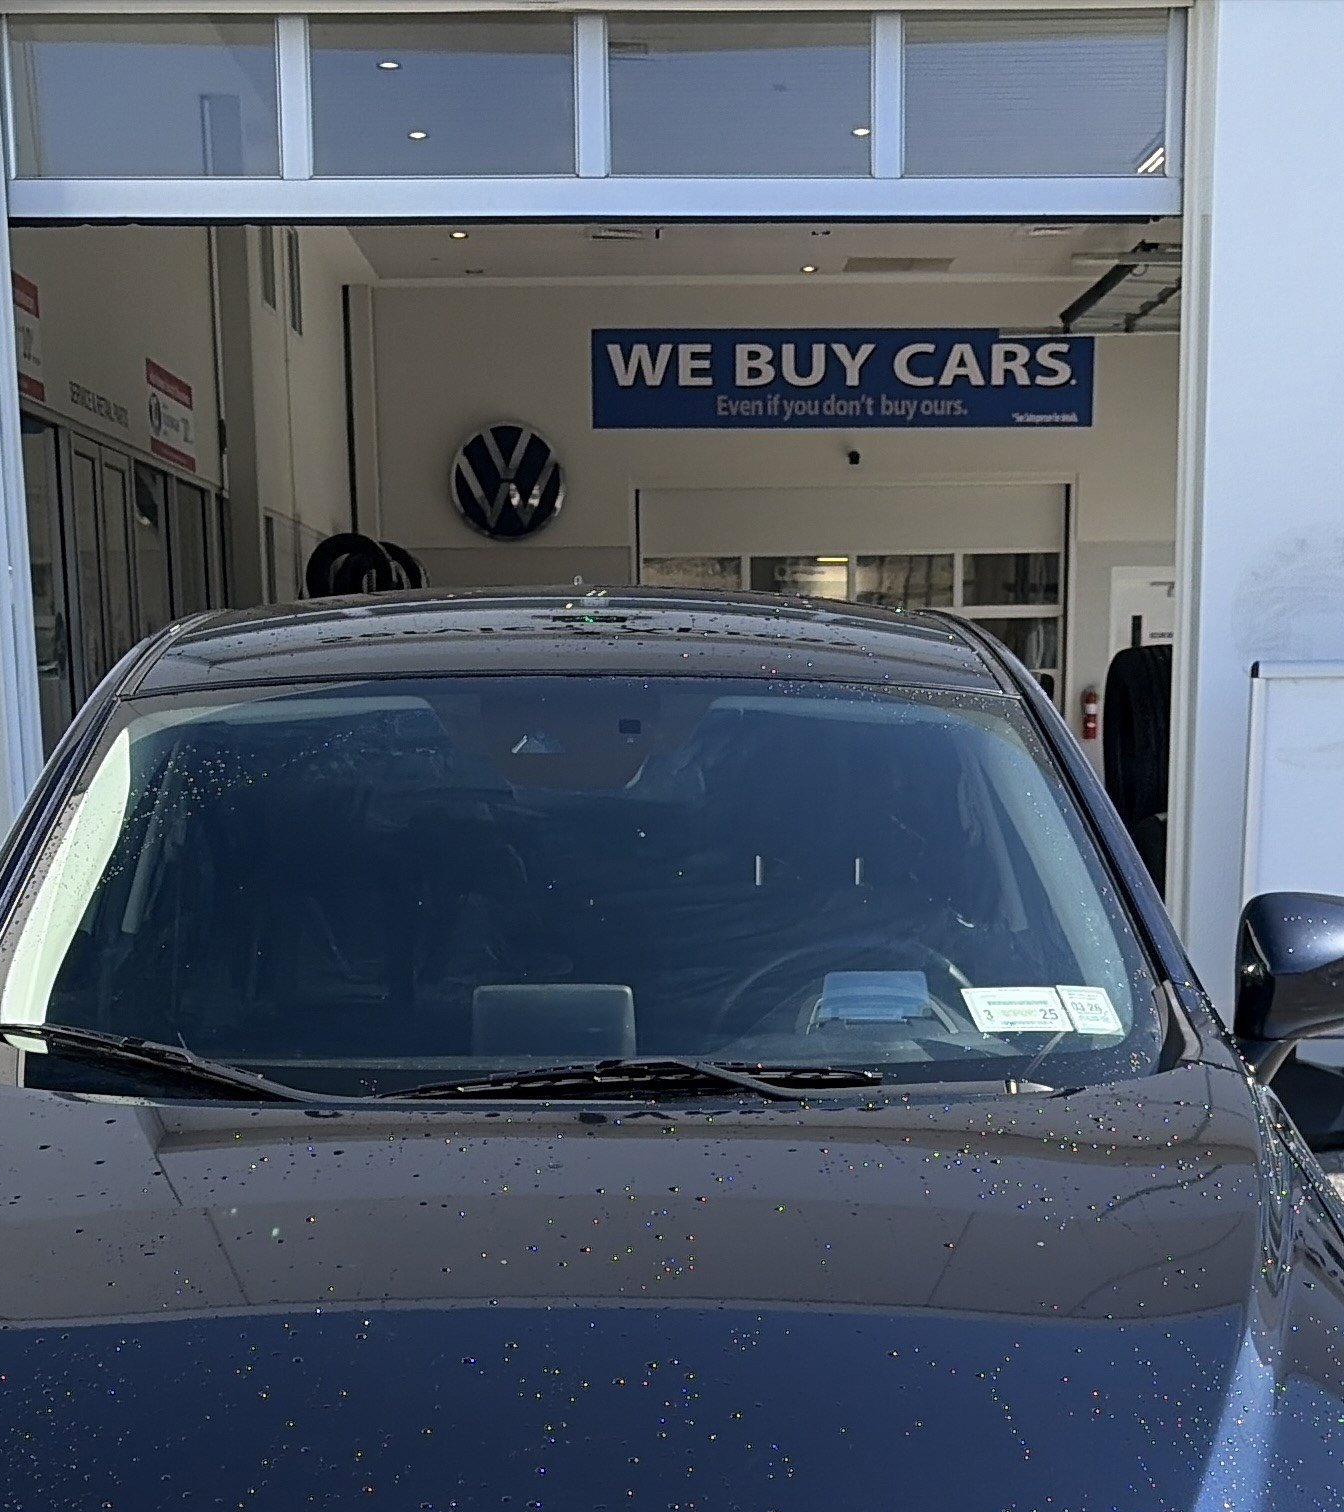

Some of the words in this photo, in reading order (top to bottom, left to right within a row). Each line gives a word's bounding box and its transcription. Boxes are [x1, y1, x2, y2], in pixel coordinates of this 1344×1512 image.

[606, 343, 713, 387] WE
[735, 343, 877, 387] BUY
[893, 342, 1078, 387] CARS.
[716, 395, 763, 416] Even
[766, 394, 781, 416] if
[782, 399, 819, 421] you
[880, 394, 916, 421] buy
[920, 399, 968, 416] ours.
[983, 1009, 994, 1021] 3
[1039, 1008, 1059, 1020] 25
